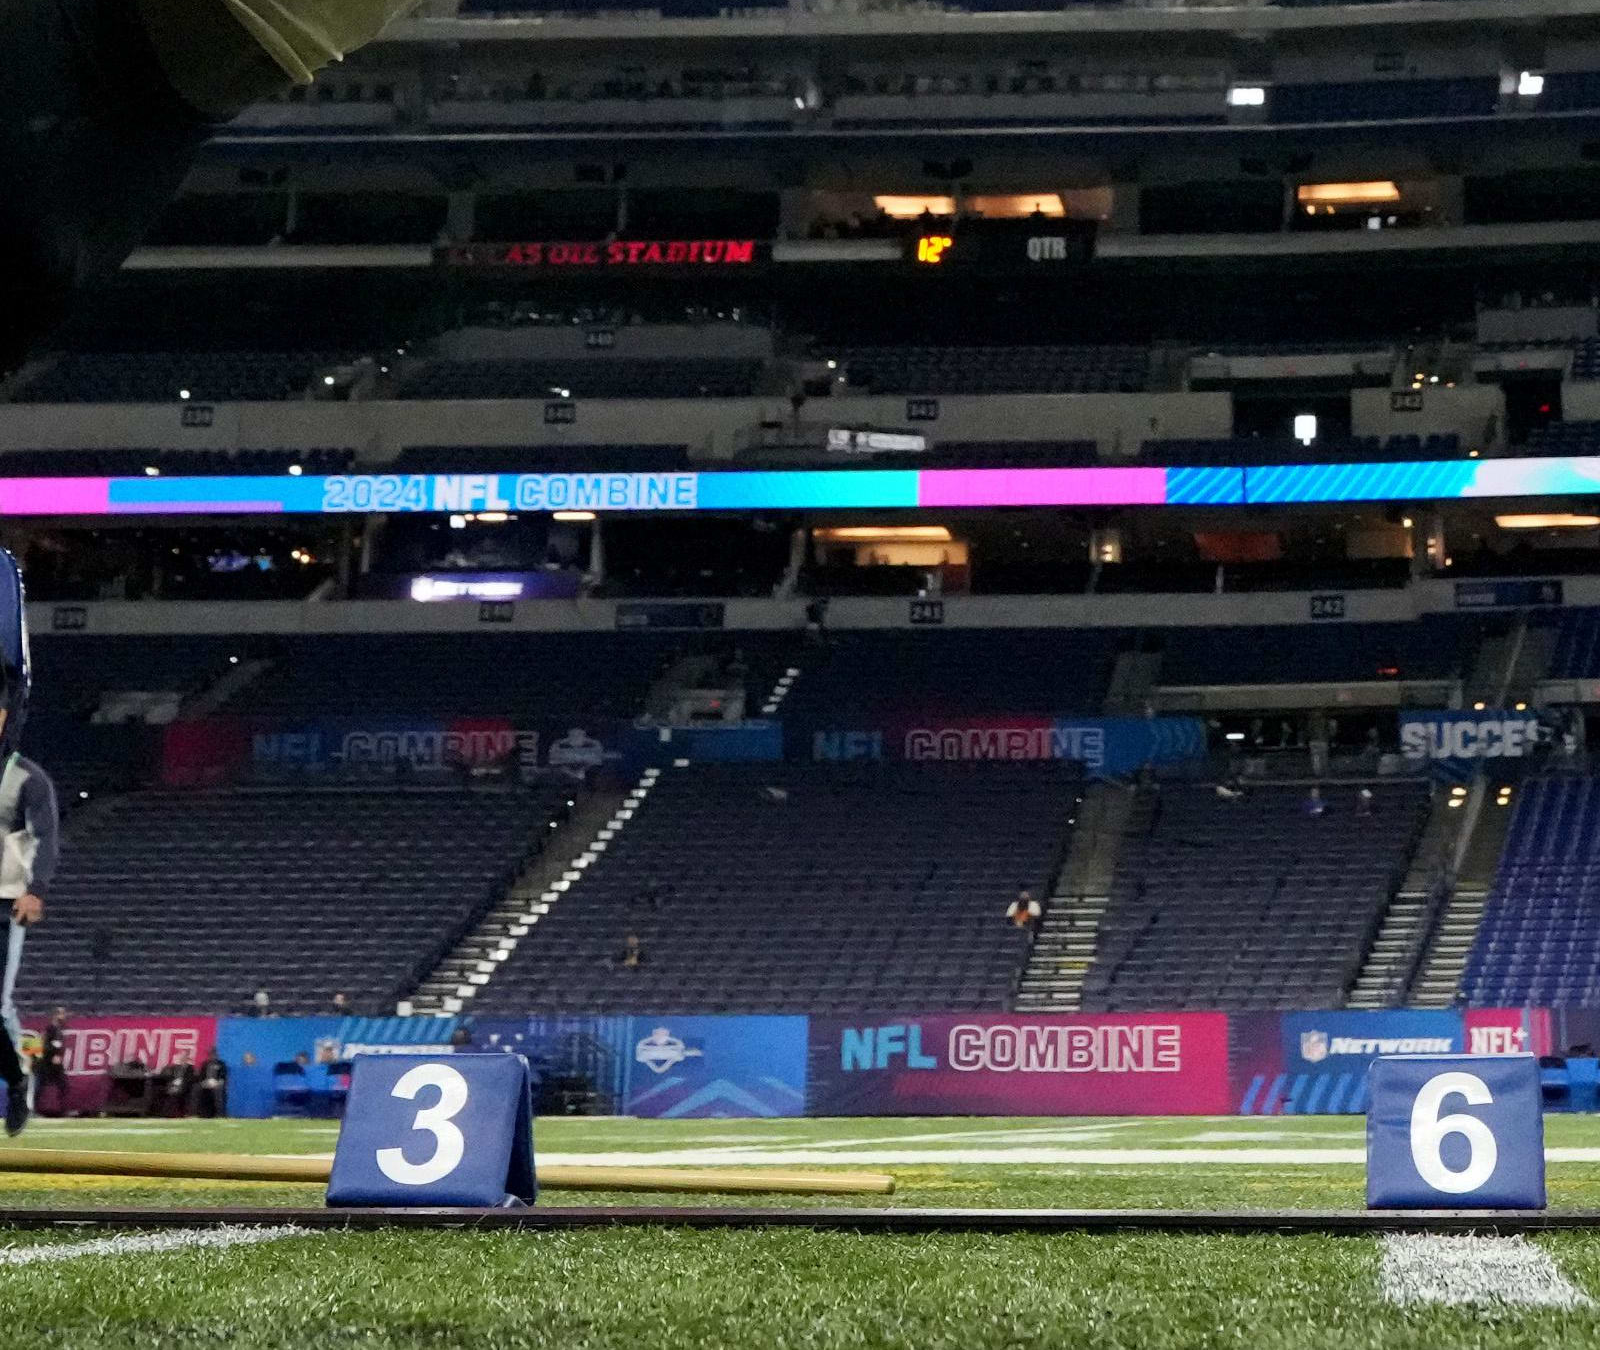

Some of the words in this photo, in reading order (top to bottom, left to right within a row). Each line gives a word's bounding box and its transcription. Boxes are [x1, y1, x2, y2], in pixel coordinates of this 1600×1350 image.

[608, 241, 754, 264] STADIUM
[1026, 237, 1067, 262] QTR
[321, 475, 427, 512] 2024
[434, 474, 510, 511] NFL
[515, 472, 698, 510] COMBINE
[342, 729, 539, 770] COMBINE
[903, 728, 1104, 767] COMBINE
[1401, 719, 1541, 758] SUCCE
[841, 1026, 936, 1071] NFL
[948, 1024, 1180, 1072] COMBINE
[1329, 1037, 1454, 1055] NETWORK
[376, 1063, 469, 1185] 3
[1409, 1071, 1498, 1194] 6
